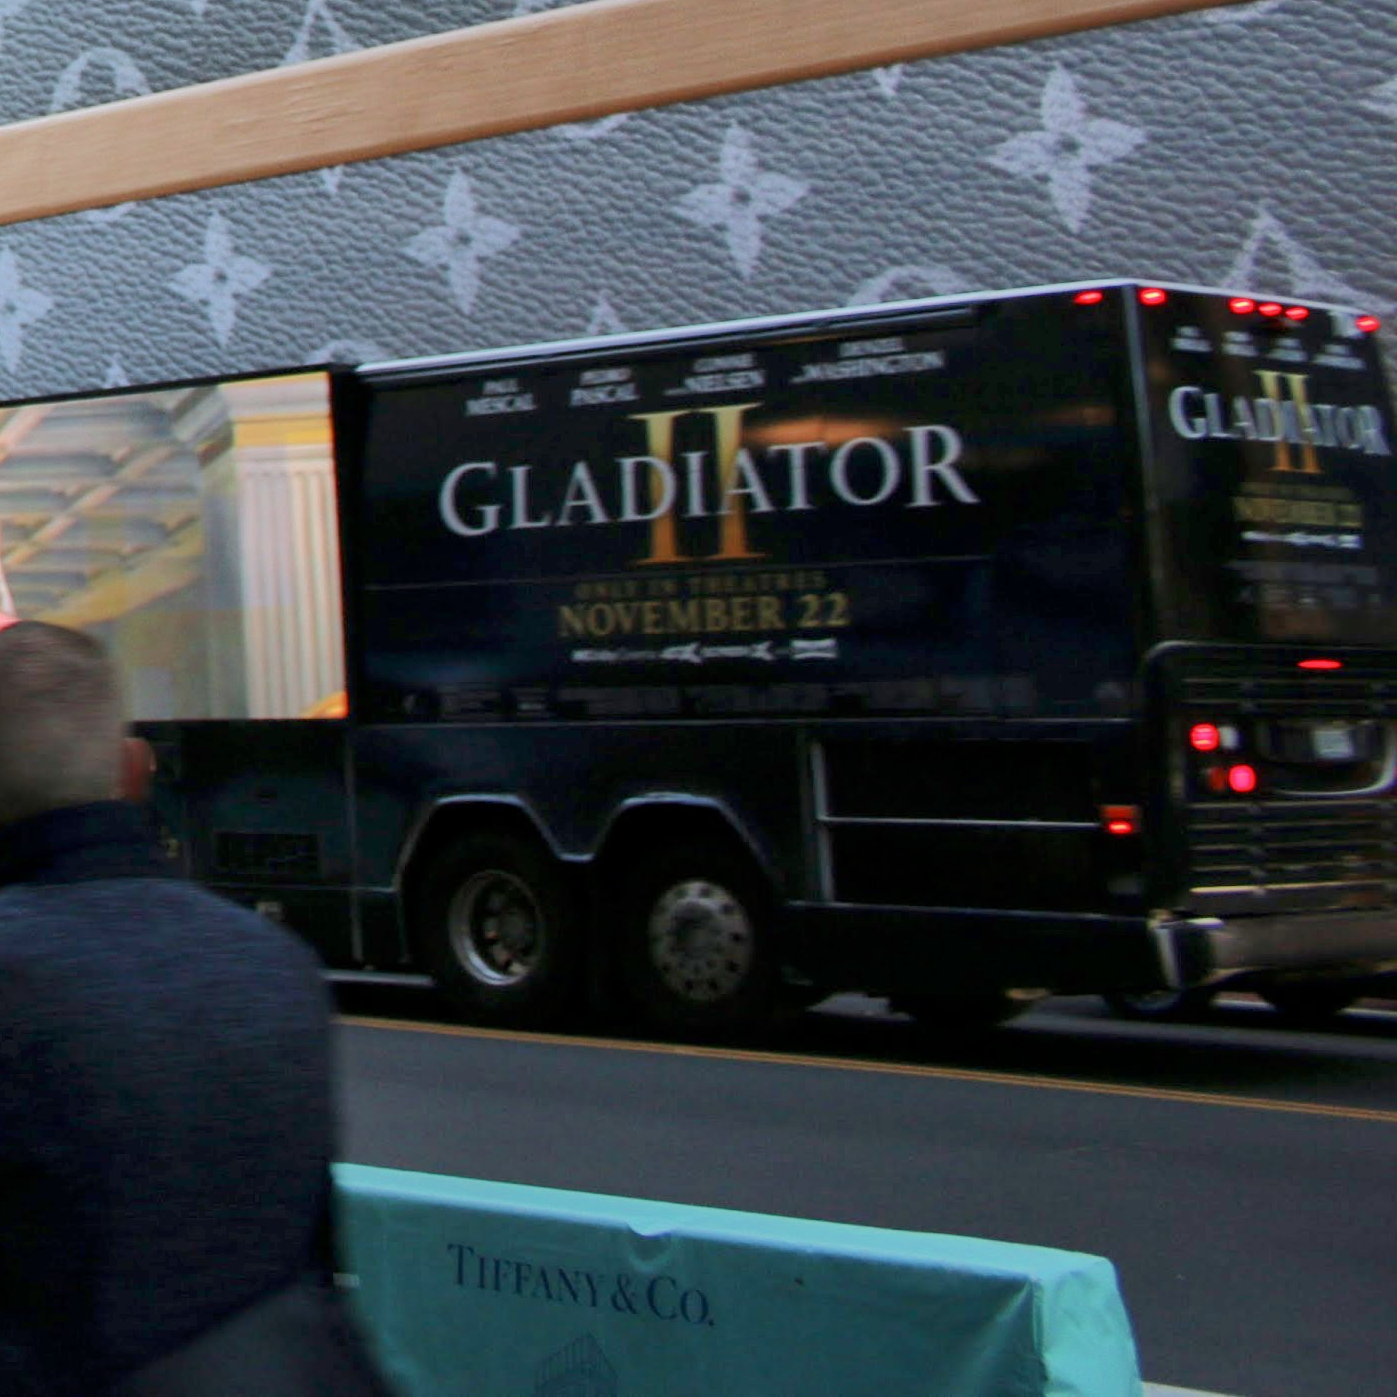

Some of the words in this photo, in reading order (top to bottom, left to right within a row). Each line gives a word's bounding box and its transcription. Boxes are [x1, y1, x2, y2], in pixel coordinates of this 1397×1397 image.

[1168, 386, 1391, 456] GLADIATOR
[438, 423, 980, 536] GLADIATOR
[629, 403, 771, 567] II
[557, 595, 787, 639] NOVEMBER
[796, 591, 853, 629] 22
[446, 1242, 605, 1309] TIFFANY
[610, 1273, 638, 1316] &
